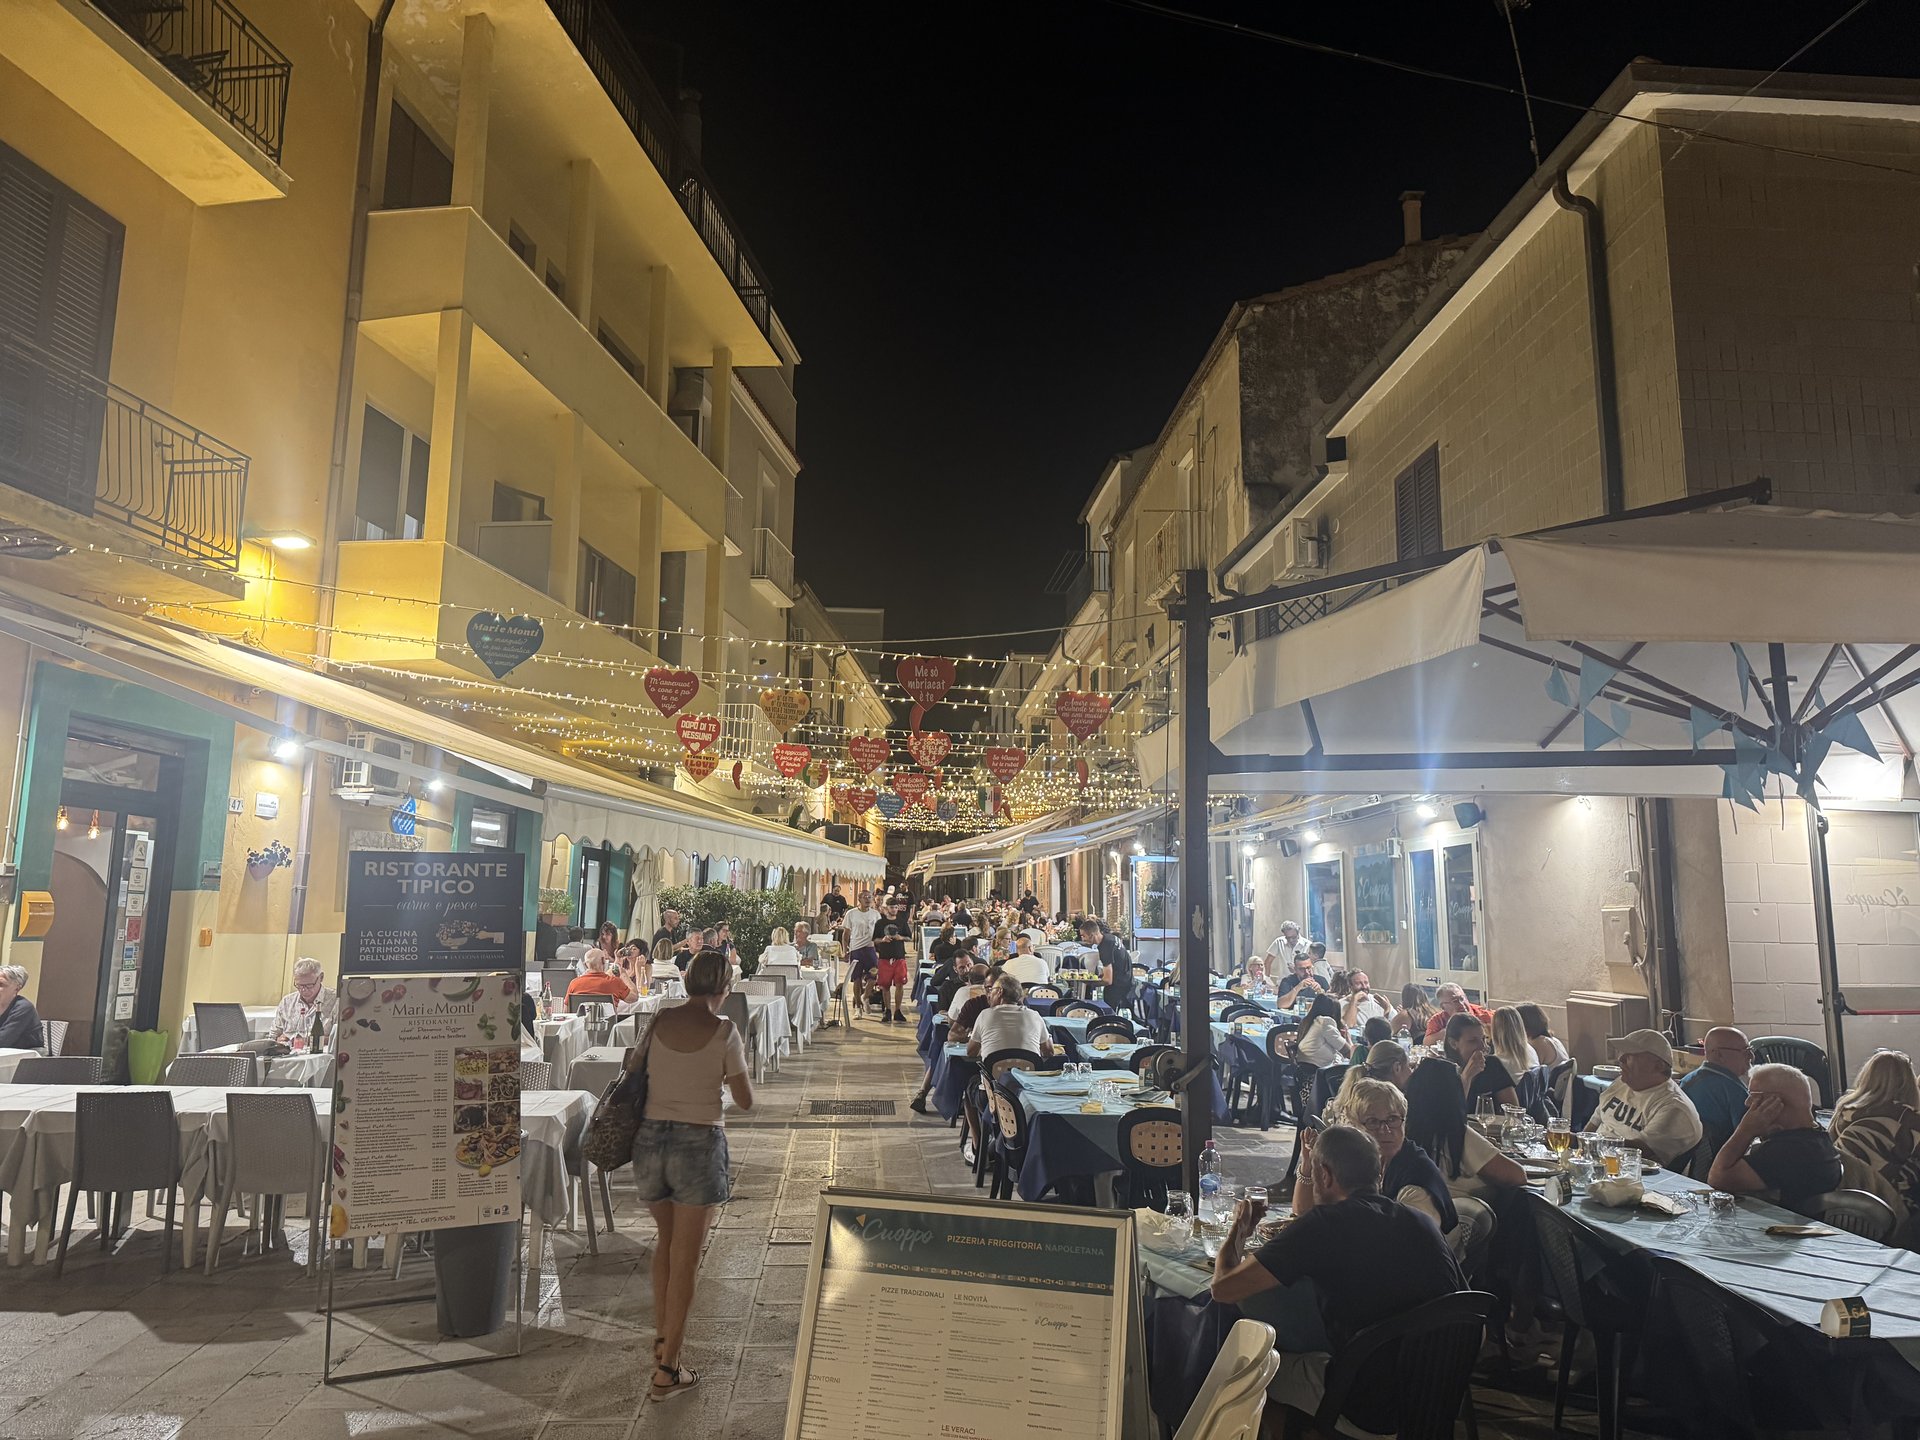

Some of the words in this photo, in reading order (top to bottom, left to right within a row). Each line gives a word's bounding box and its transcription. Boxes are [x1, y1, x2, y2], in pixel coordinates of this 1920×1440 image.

[507, 626, 539, 637] Monti
[914, 665, 928, 677] Me
[926, 692, 934, 702] te
[681, 720, 698, 729] DOPO
[700, 722, 706, 730] DI
[708, 723, 717, 732] TE
[682, 730, 713, 741] NESSUNA
[690, 760, 715, 768] LOVE
[689, 768, 709, 776] YOU
[231, 799, 241, 811] 47
[364, 861, 508, 878] RISTORANTE
[397, 879, 475, 894] TIPICO
[396, 900, 430, 911] carne
[435, 901, 442, 910] e
[443, 900, 478, 917] pesce
[360, 930, 373, 938] LA
[377, 930, 418, 938] CUCINA
[360, 938, 408, 946] ITALIANA
[392, 1003, 424, 1016] Mari
[435, 1002, 475, 1014] Monti
[946, 1234, 986, 1246] PIZZERIA
[987, 1238, 1042, 1251] FRIGGITORIA
[1044, 1243, 1105, 1256] NAPOLETANA
[881, 1286, 899, 1294] PIZZE
[900, 1288, 945, 1299] TRADIZIONALI
[808, 1374, 841, 1384] CONTORNI
[951, 1426, 976, 1435] VERACI
